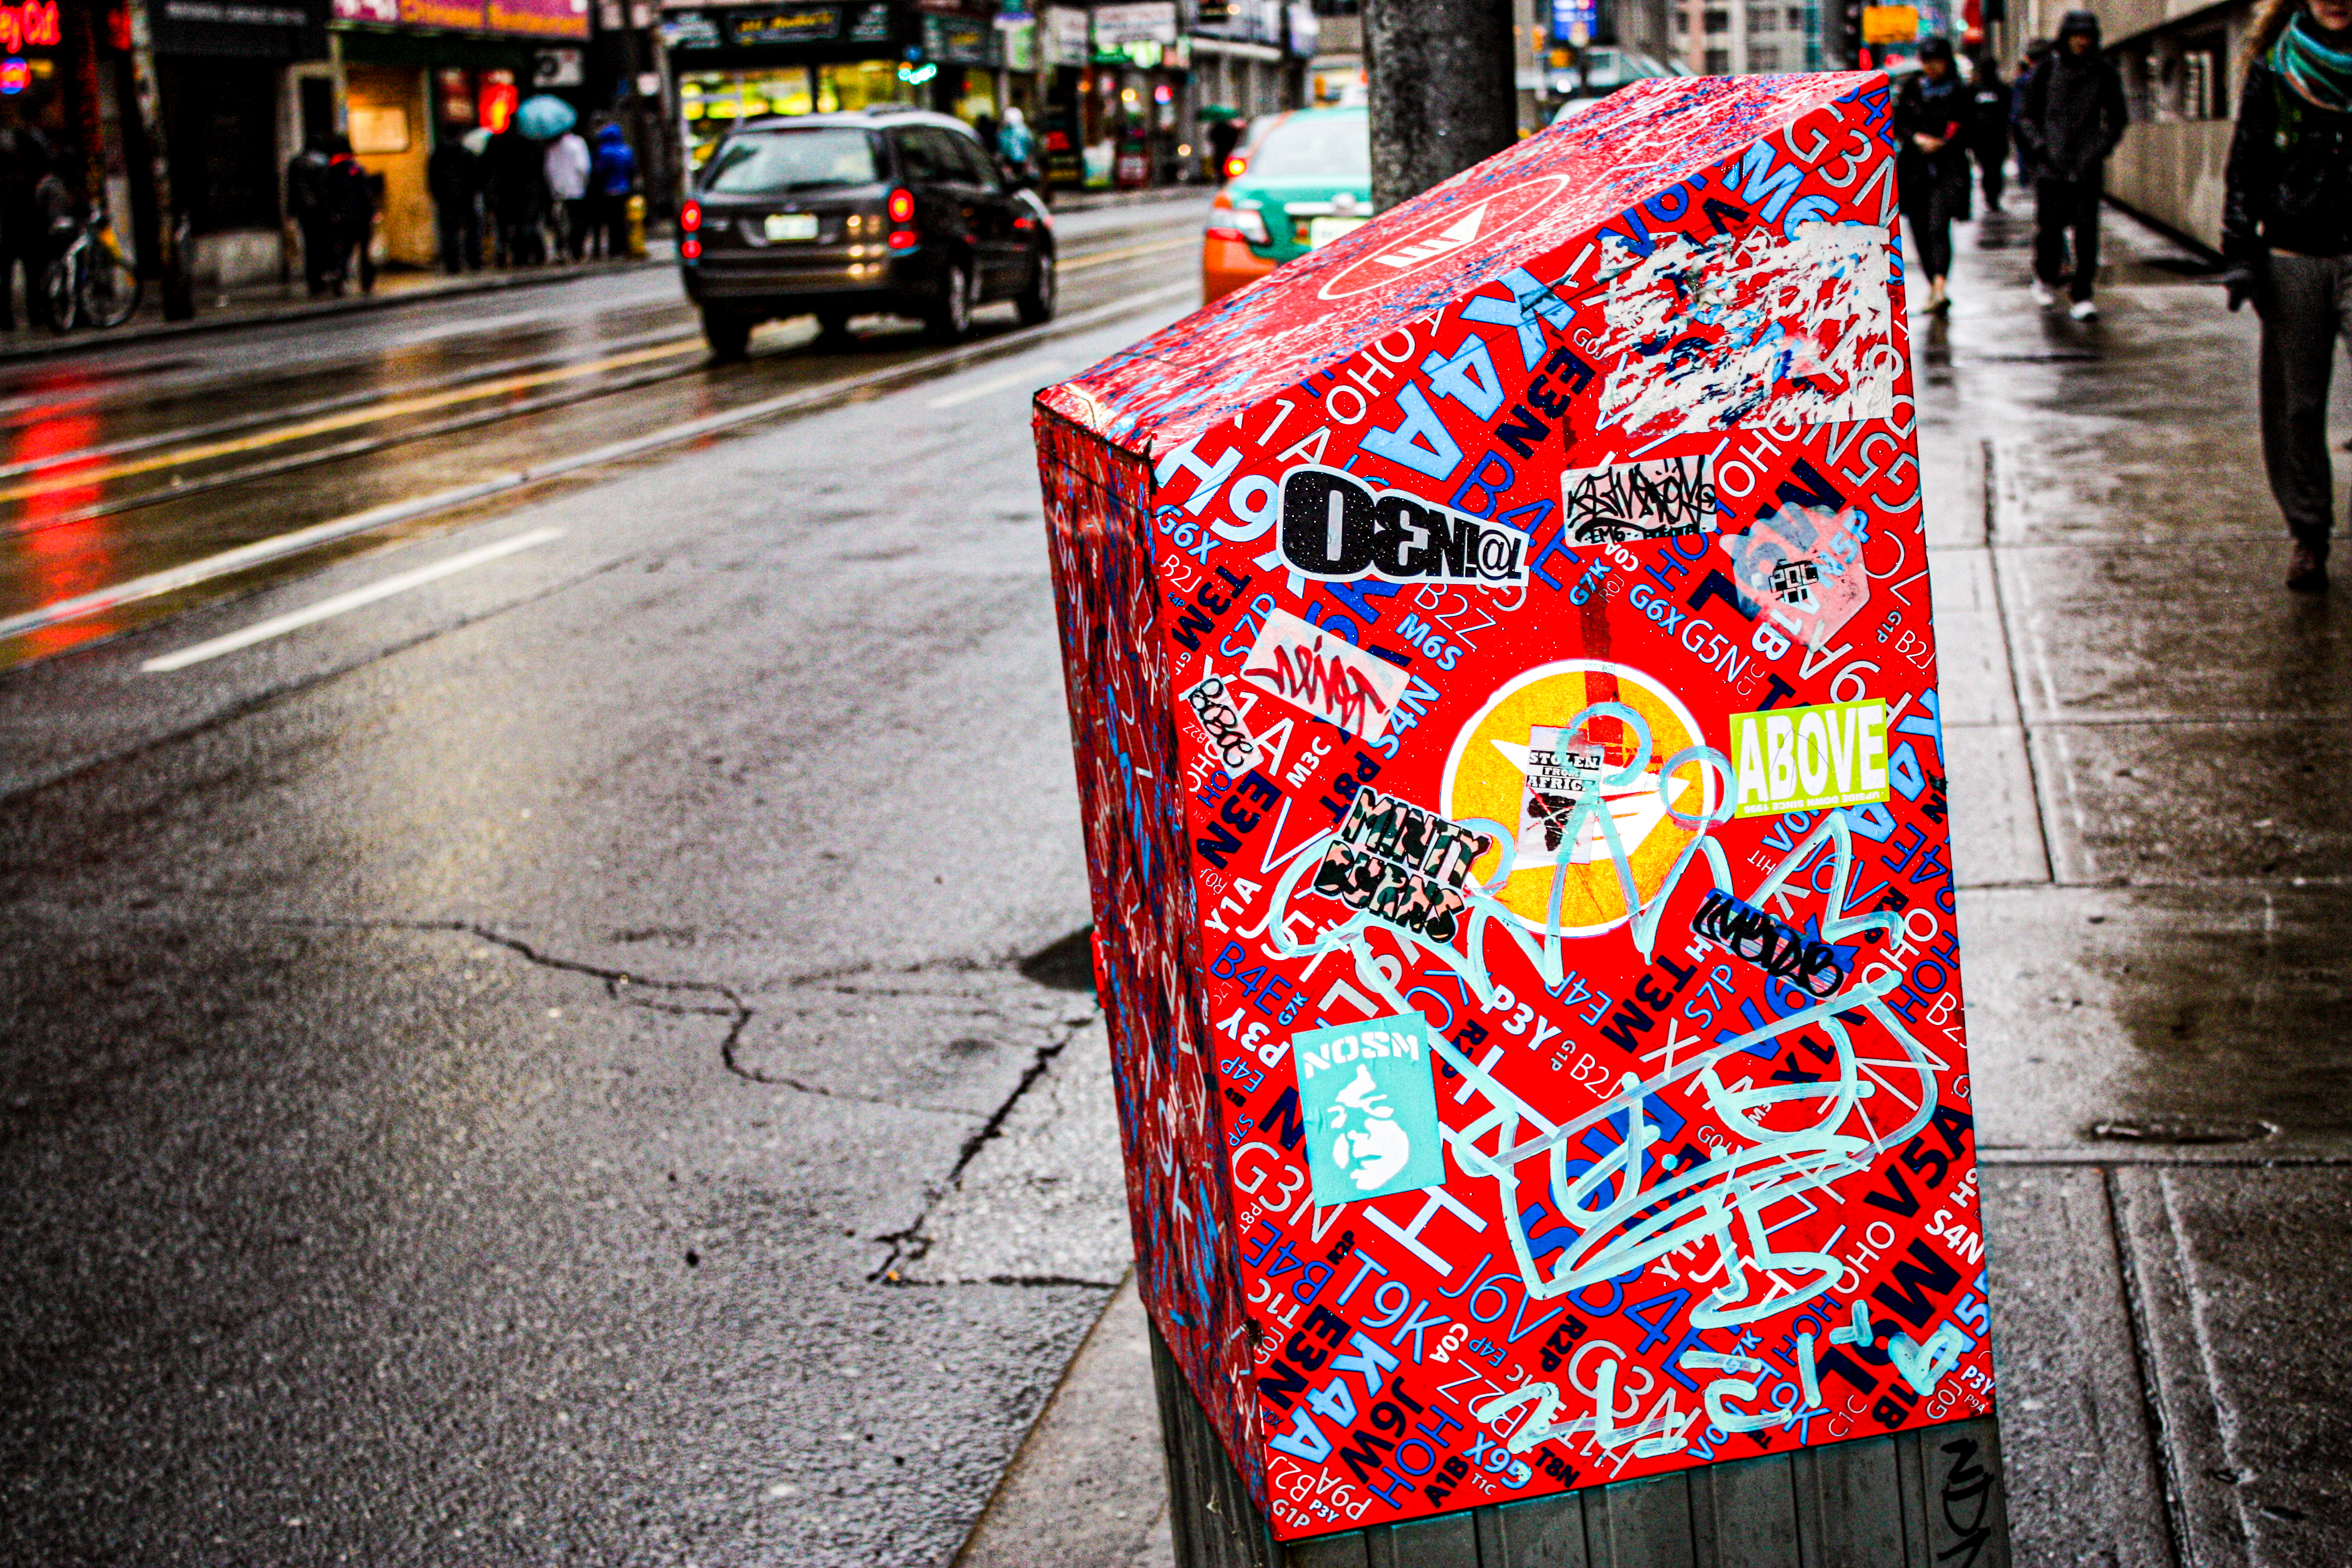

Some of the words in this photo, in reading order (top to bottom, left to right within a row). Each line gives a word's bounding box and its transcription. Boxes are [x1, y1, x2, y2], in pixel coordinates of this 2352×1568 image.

[1722, 138, 1864, 242] M6
[1783, 102, 1899, 228] G3N
[1357, 267, 1577, 481] K4A
[1494, 346, 1596, 460] E3N
[1234, 398, 1331, 465] 1A
[1155, 433, 1306, 599] H9
[1155, 504, 1222, 566] G6X
[1161, 554, 1202, 594] B2J
[1569, 557, 1613, 606] G7K
[1172, 565, 1252, 651] T3M
[1413, 581, 1498, 651] B2Z
[1629, 583, 1686, 636] G6X
[1875, 611, 1902, 644] G1P
[1395, 612, 1464, 671] M6S
[1681, 619, 1751, 683] G5N
[1894, 629, 1936, 670] B2J
[1736, 662, 1766, 696] C1C
[1368, 673, 1441, 761] S4N
[1285, 736, 1332, 790] M3C
[1529, 749, 1601, 769] STOLEN
[1738, 704, 1887, 805] ABOVE
[1319, 750, 1382, 825] P8T
[1743, 802, 1769, 815] 1996
[1772, 798, 1805, 812] SINCE
[1806, 795, 1833, 807] DOWN
[1835, 791, 1880, 804] UPSIDE
[1196, 770, 1283, 870] E3N
[1204, 876, 1262, 934] Y1A
[1210, 939, 1293, 1016] B4E
[1599, 954, 1698, 1054] T3M
[1684, 963, 1736, 1030] S7P
[1277, 991, 1309, 1026] G7K
[1479, 984, 1562, 1052] P3Y
[1216, 1007, 1291, 1069] P3Y
[1303, 1031, 1420, 1080] NOSM
[1550, 1038, 1577, 1071] G1P
[1220, 1055, 1266, 1094] E4P
[1570, 1053, 1623, 1100] B2J
[1228, 1113, 1255, 1147] S7P
[1863, 1103, 1974, 1219] V5A
[1231, 1140, 1348, 1244] G3N
[1239, 1201, 1263, 1235] P8T
[1243, 1218, 1335, 1306] B4E
[1325, 1229, 1356, 1266] R2P
[1924, 1207, 1985, 1266] S4N
[1246, 1277, 1301, 1330] T1C
[1336, 1247, 1453, 1365] T9K
[1437, 1252, 1565, 1344] J6V
[1257, 1304, 1352, 1411] E3N
[1467, 1336, 1509, 1369] E4P
[1539, 1313, 1588, 1373] R2P
[1722, 1329, 1763, 1375] G7K
[1268, 1330, 1402, 1465] K4A
[1435, 1358, 1529, 1439] B2Z
[1960, 1364, 1996, 1397] P3Y
[1338, 1375, 1425, 1485] J6W
[1828, 1393, 1868, 1438] C1C
[1267, 1455, 1317, 1504] B2J
[1315, 1466, 1373, 1521] P9A
[1424, 1455, 1469, 1509] A1B
[1470, 1472, 1497, 1497] T1C
[1533, 1446, 1582, 1488] T8N
[1271, 1498, 1311, 1529] G1P
[1308, 1498, 1340, 1525] P3Y
